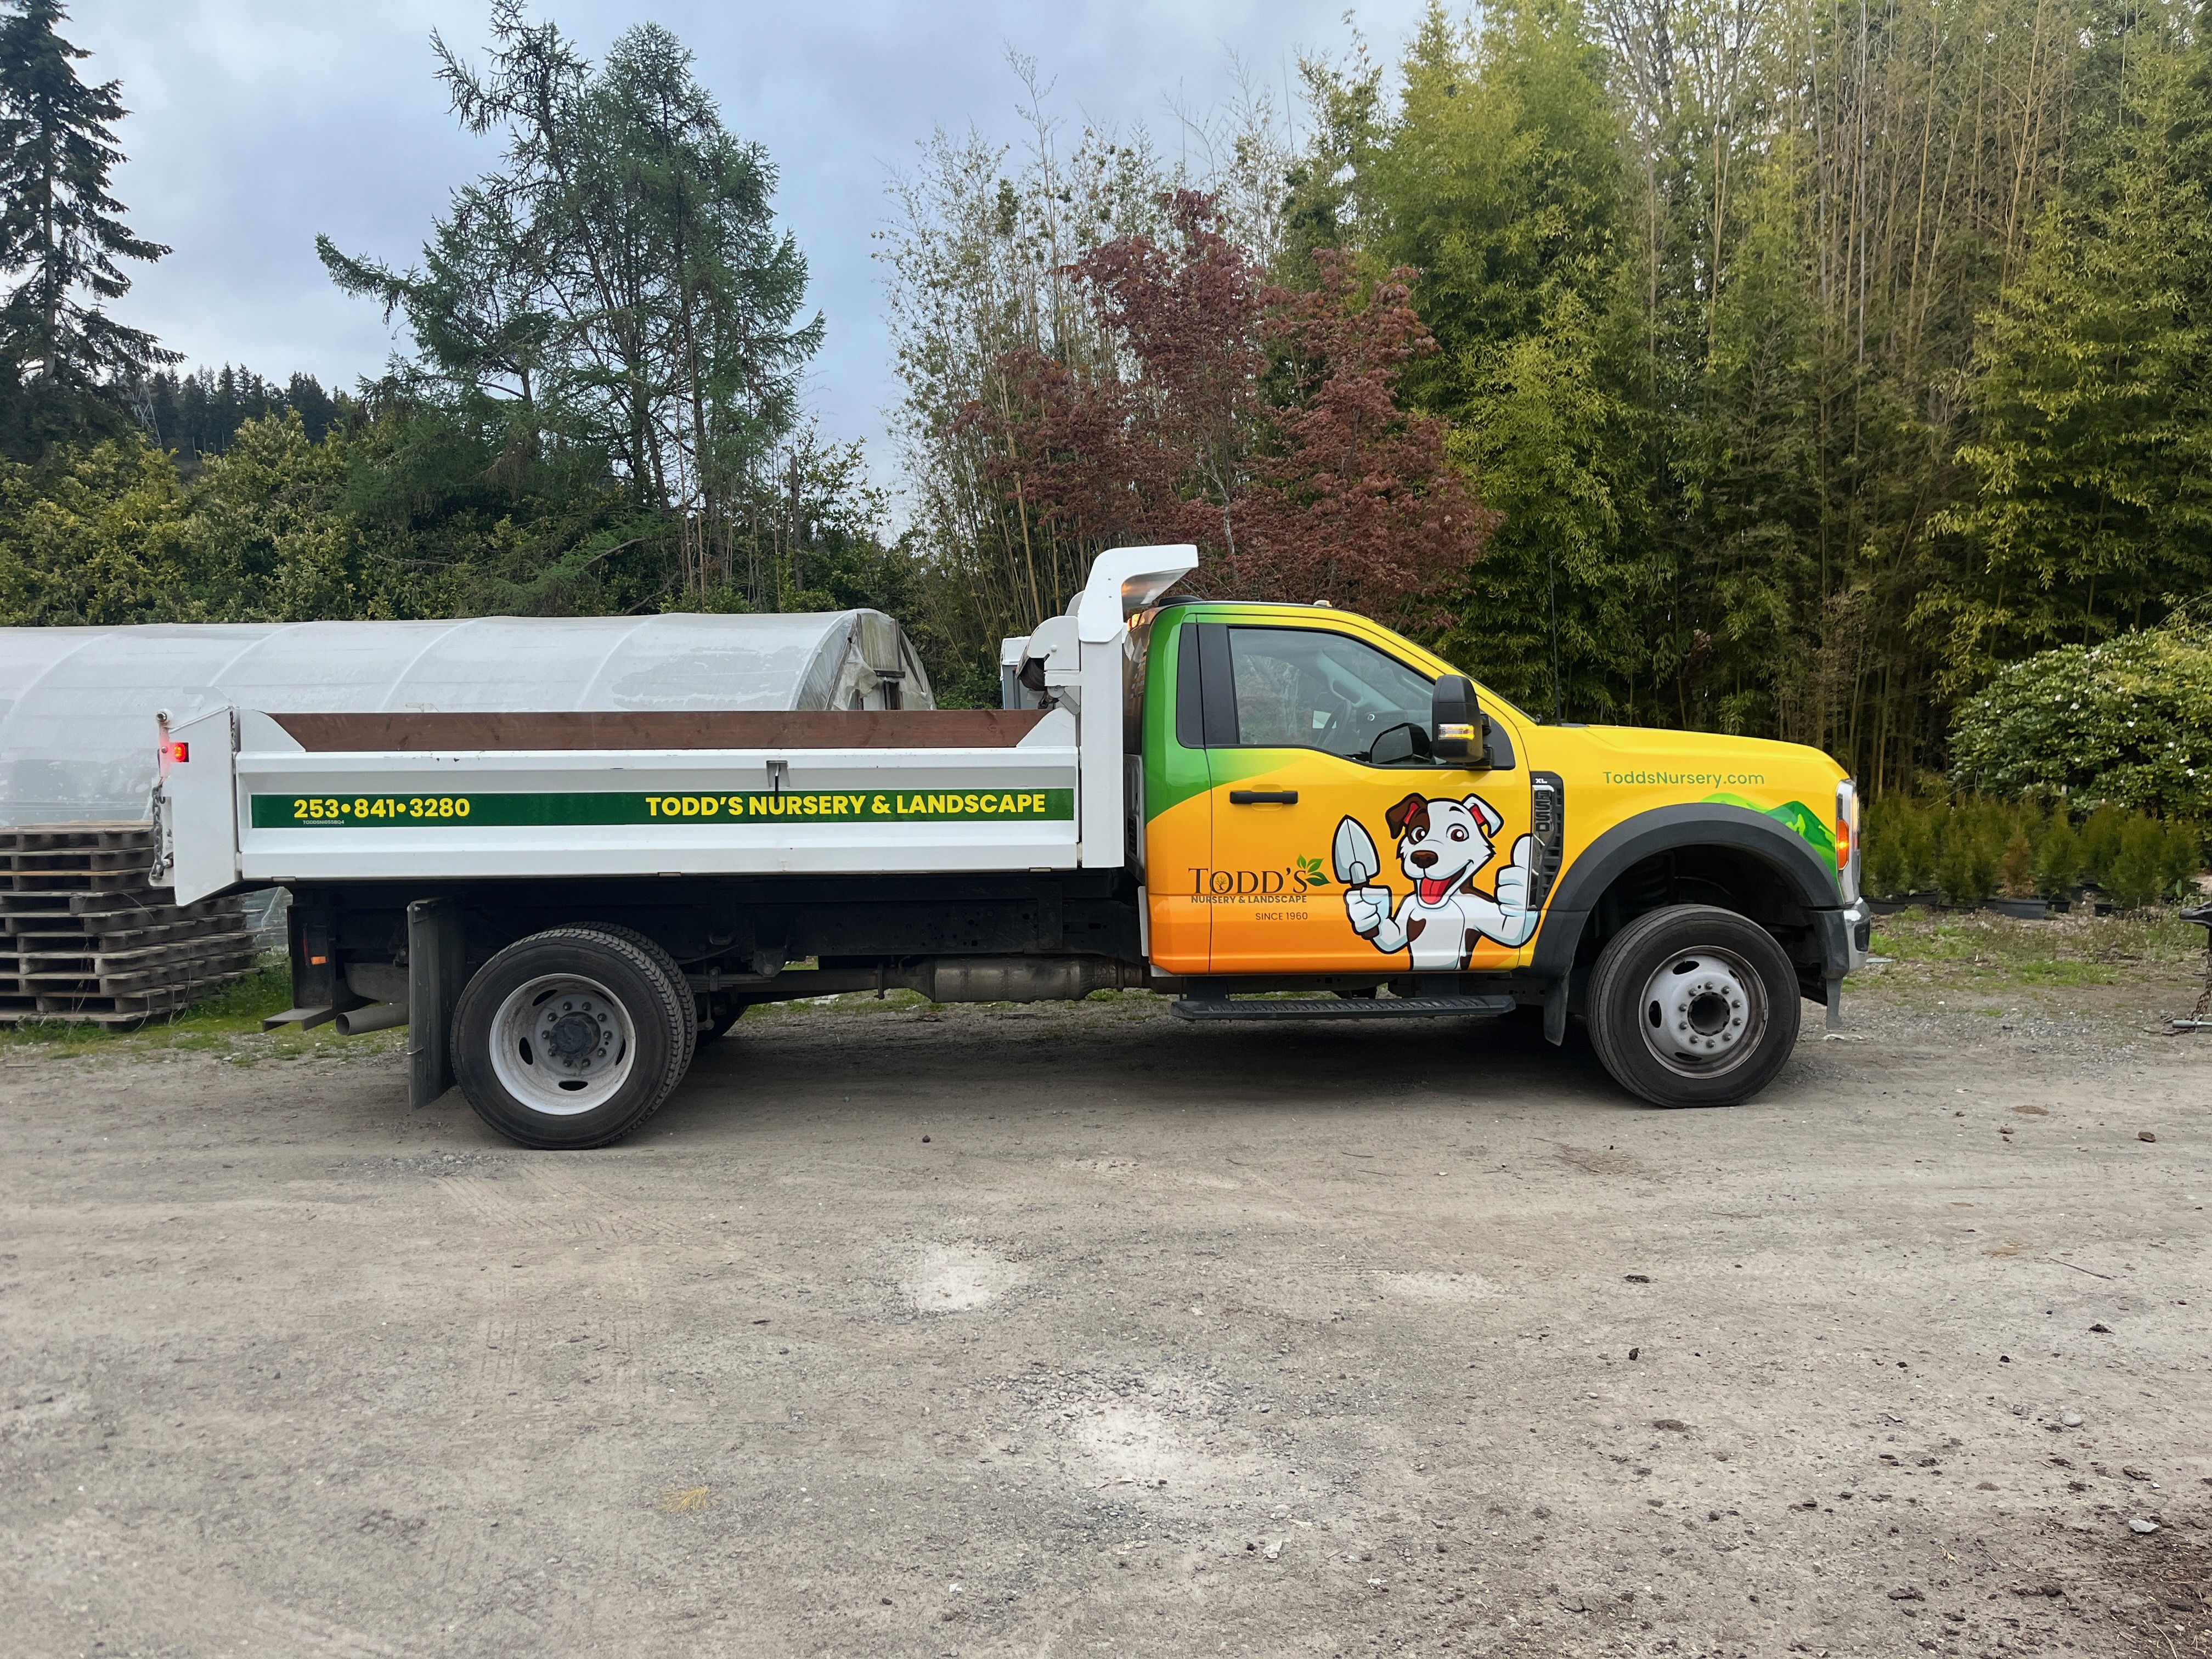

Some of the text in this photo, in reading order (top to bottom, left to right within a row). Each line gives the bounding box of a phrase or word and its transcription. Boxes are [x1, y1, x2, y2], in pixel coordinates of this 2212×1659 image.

[1602, 771, 1765, 789] ToddsNursery.com
[645, 794, 1045, 816] TODD'S NURSERY & LANDSCAPE
[1188, 867, 1308, 895] TODD'S
[1191, 895, 1235, 904] NURSERY
[1255, 912, 1308, 921] SINCE 1960
